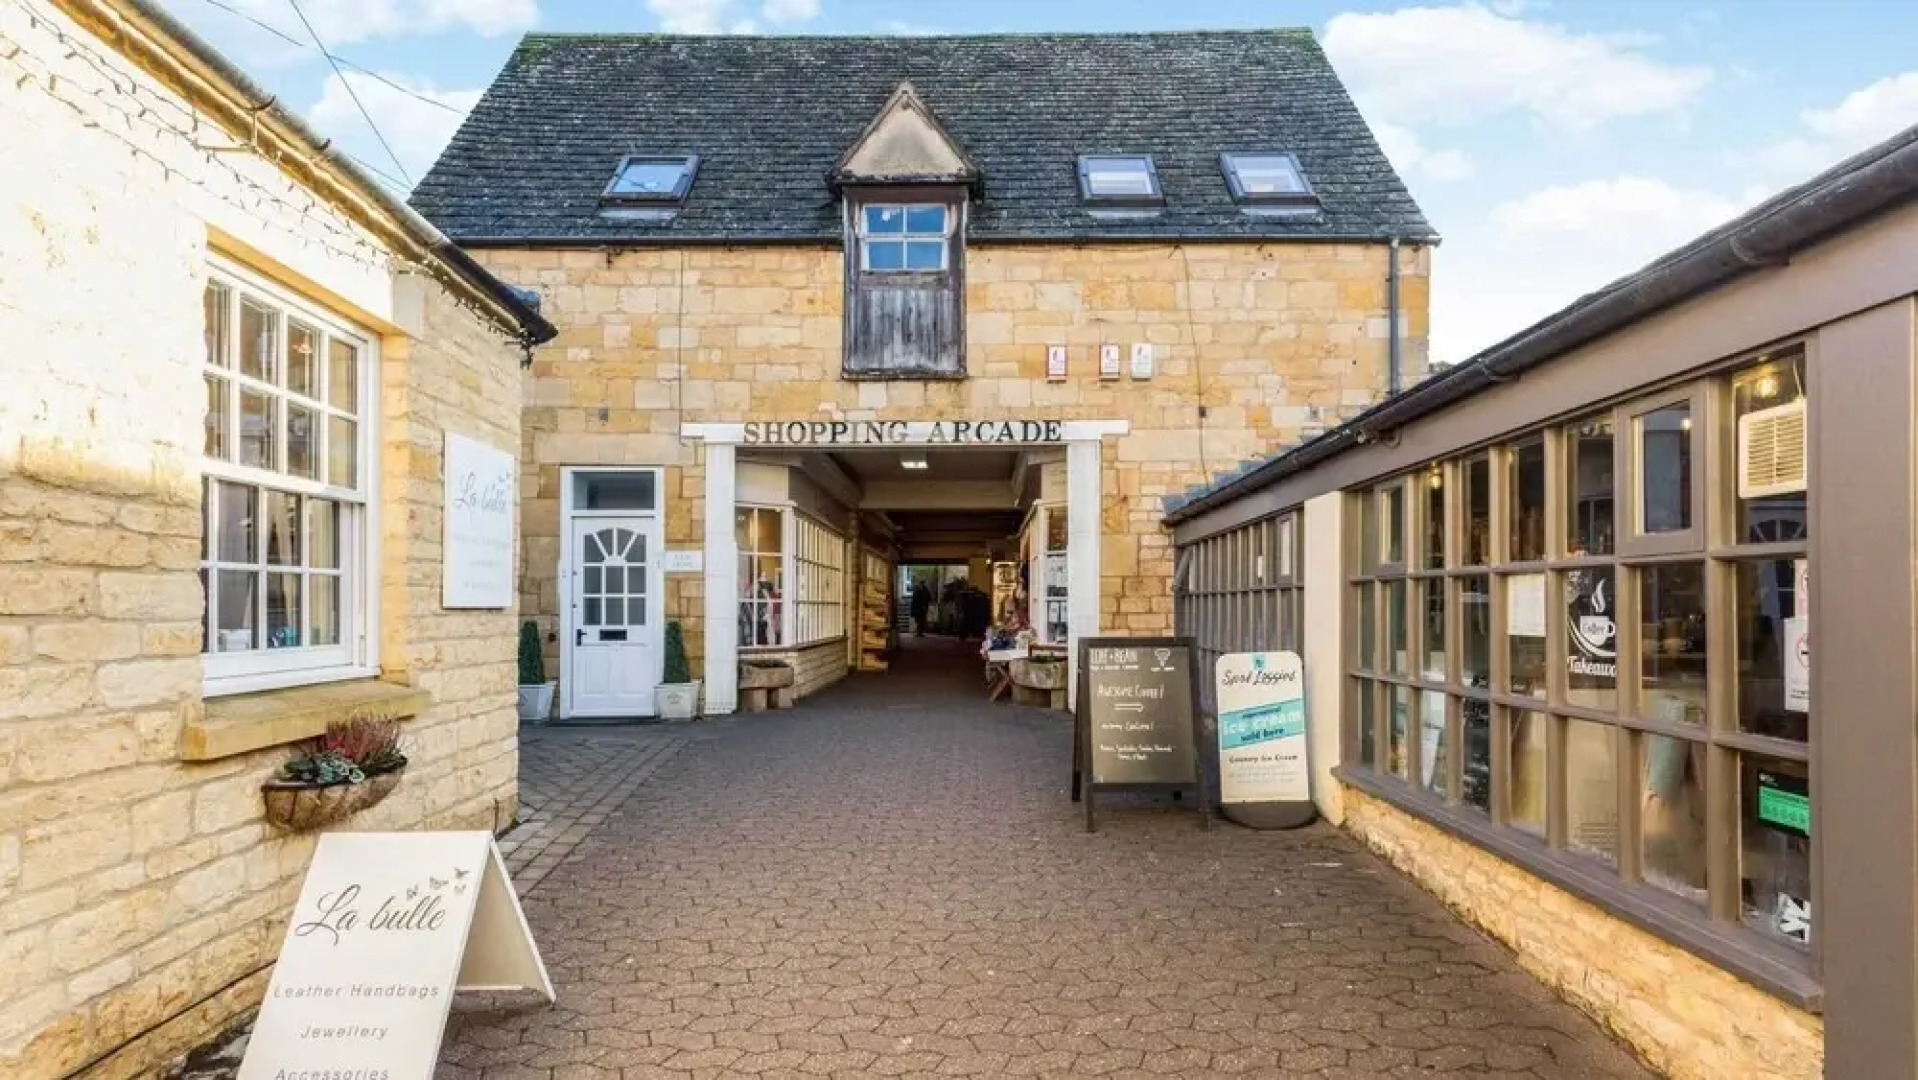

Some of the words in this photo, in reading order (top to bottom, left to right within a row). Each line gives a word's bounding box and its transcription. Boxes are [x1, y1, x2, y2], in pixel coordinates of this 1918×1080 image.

[743, 420, 908, 444] SHOPPING
[927, 420, 1062, 443] ARCADE
[1567, 656, 1616, 677] Takeawa
[1263, 727, 1286, 739] here
[294, 884, 360, 947] La
[368, 895, 446, 932] bulle
[273, 983, 343, 998] Leather
[350, 982, 440, 1000] Handbags
[300, 1024, 389, 1040] Jewellery
[274, 1067, 390, 1080] Accessories
